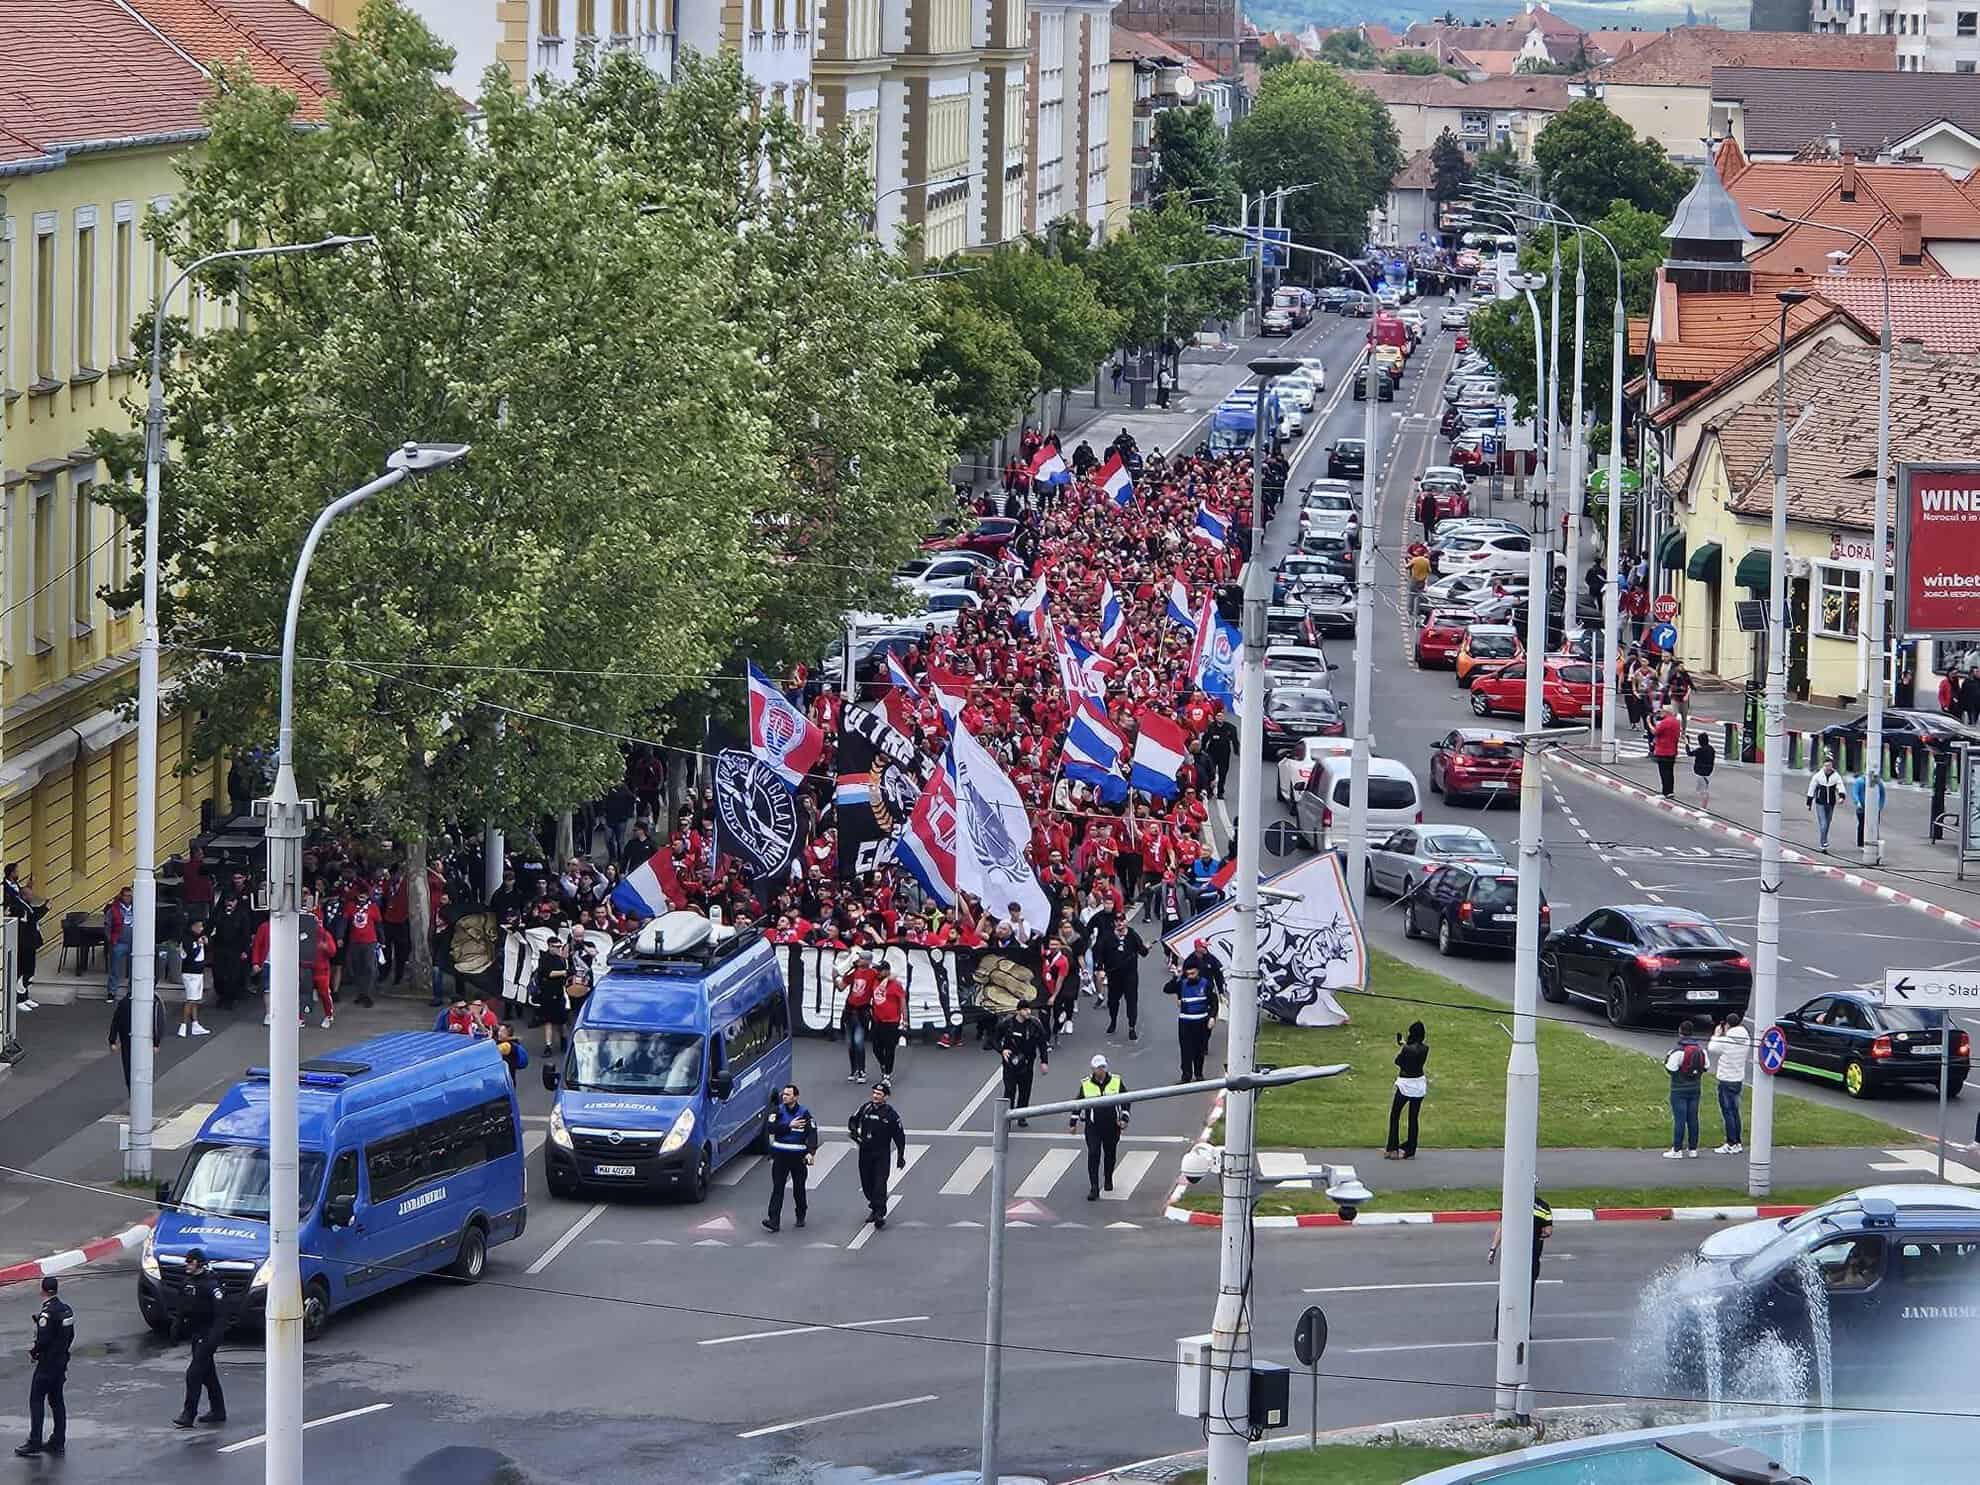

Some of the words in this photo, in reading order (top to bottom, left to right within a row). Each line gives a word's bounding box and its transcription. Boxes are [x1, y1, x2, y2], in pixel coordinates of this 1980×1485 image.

[1923, 573, 1980, 588] winbet
[1656, 601, 1676, 613] STOP
[1948, 983, 1978, 997] Stad
[398, 1186, 447, 1216] JANDARMERIA
